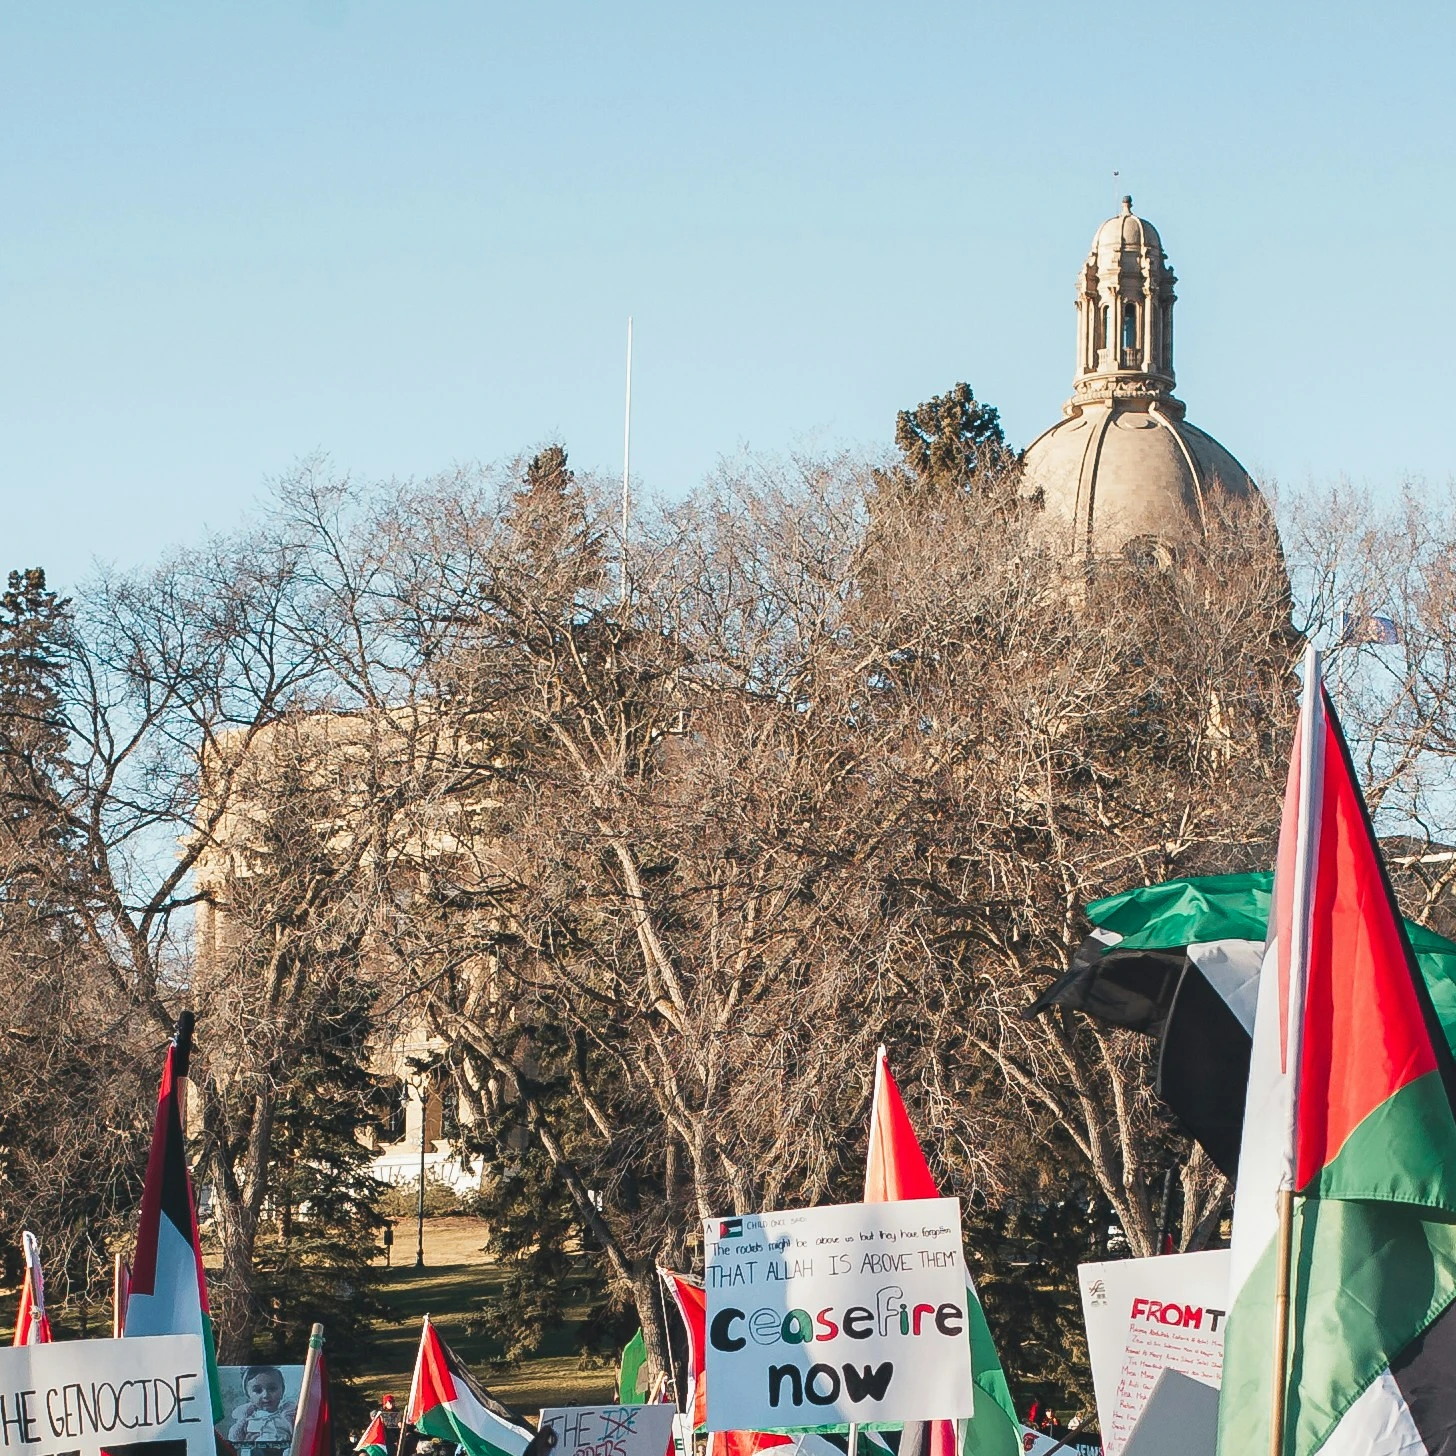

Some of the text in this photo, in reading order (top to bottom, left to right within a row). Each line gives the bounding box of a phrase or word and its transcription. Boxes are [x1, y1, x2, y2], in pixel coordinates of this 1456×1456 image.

[746, 1220, 768, 1230] CHILD
[768, 1239, 791, 1254] might
[795, 1239, 808, 1248] be
[815, 1236, 840, 1246] above
[859, 1230, 875, 1241] but
[879, 1230, 897, 1243] they
[900, 1229, 919, 1239] have
[706, 1261, 759, 1288] THAT
[766, 1258, 814, 1282] ALLAH
[828, 1253, 852, 1276] IS
[860, 1252, 913, 1275] ABOVE
[710, 1285, 964, 1353] ceasefire
[1130, 1297, 1203, 1330] FROM
[767, 1361, 894, 1408] now
[46, 1373, 202, 1438] GENOCIDE
[543, 1411, 596, 1448] THE
